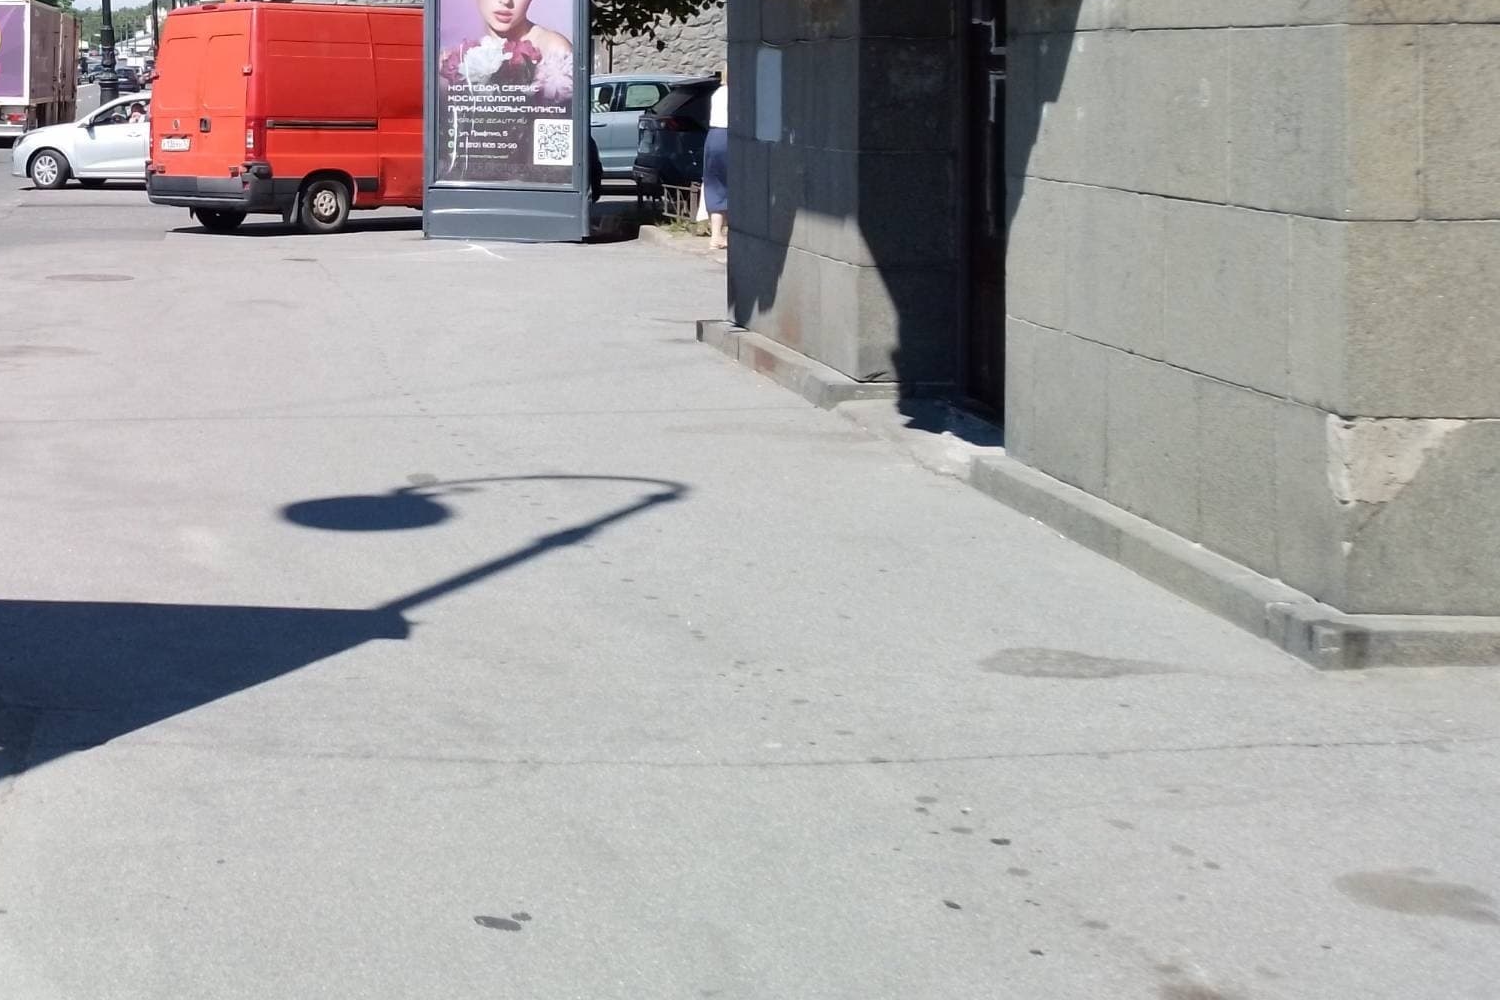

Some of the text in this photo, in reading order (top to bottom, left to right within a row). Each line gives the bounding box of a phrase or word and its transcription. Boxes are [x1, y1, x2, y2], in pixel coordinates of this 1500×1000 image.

[448, 83, 540, 92] НОГТЕВОЙ СЕРВИС
[447, 95, 526, 103] КОСМЕТОЛОГИЯ
